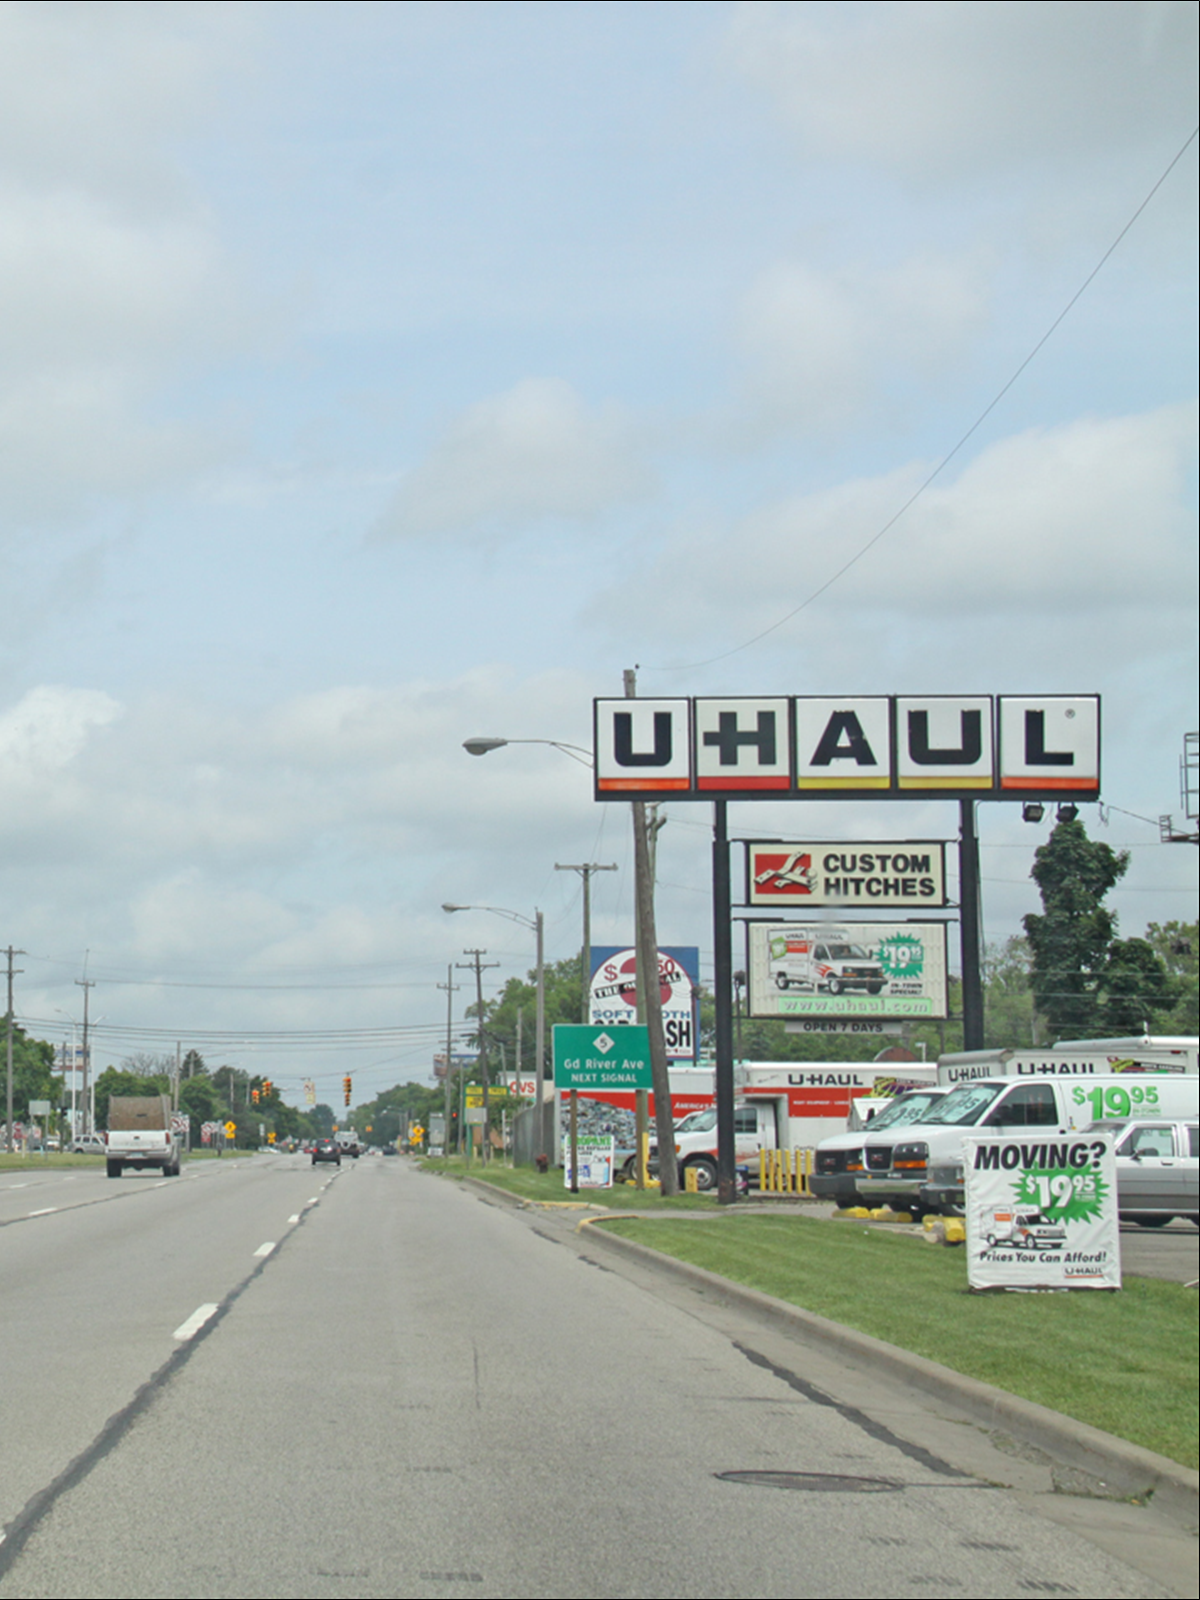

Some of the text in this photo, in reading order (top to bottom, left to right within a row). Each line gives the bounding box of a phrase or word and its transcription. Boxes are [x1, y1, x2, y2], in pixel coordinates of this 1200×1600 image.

[822, 853, 931, 874] CUSTOM
[823, 877, 936, 897] HITCHES
[783, 999, 928, 1013] www.uhaul.com
[592, 1010, 691, 1019] SOFT OTH
[803, 1021, 884, 1033] OPEN 7 DAYS
[666, 1020, 691, 1048] SH
[599, 1037, 608, 1048] 5
[563, 1058, 645, 1070] Gd River Ave
[571, 1073, 637, 1083] NEXT SIGNAL
[509, 1081, 536, 1094] CVS
[974, 1141, 1107, 1170] MOVING?
[979, 1251, 1107, 1263] Prices You Can Afford!
